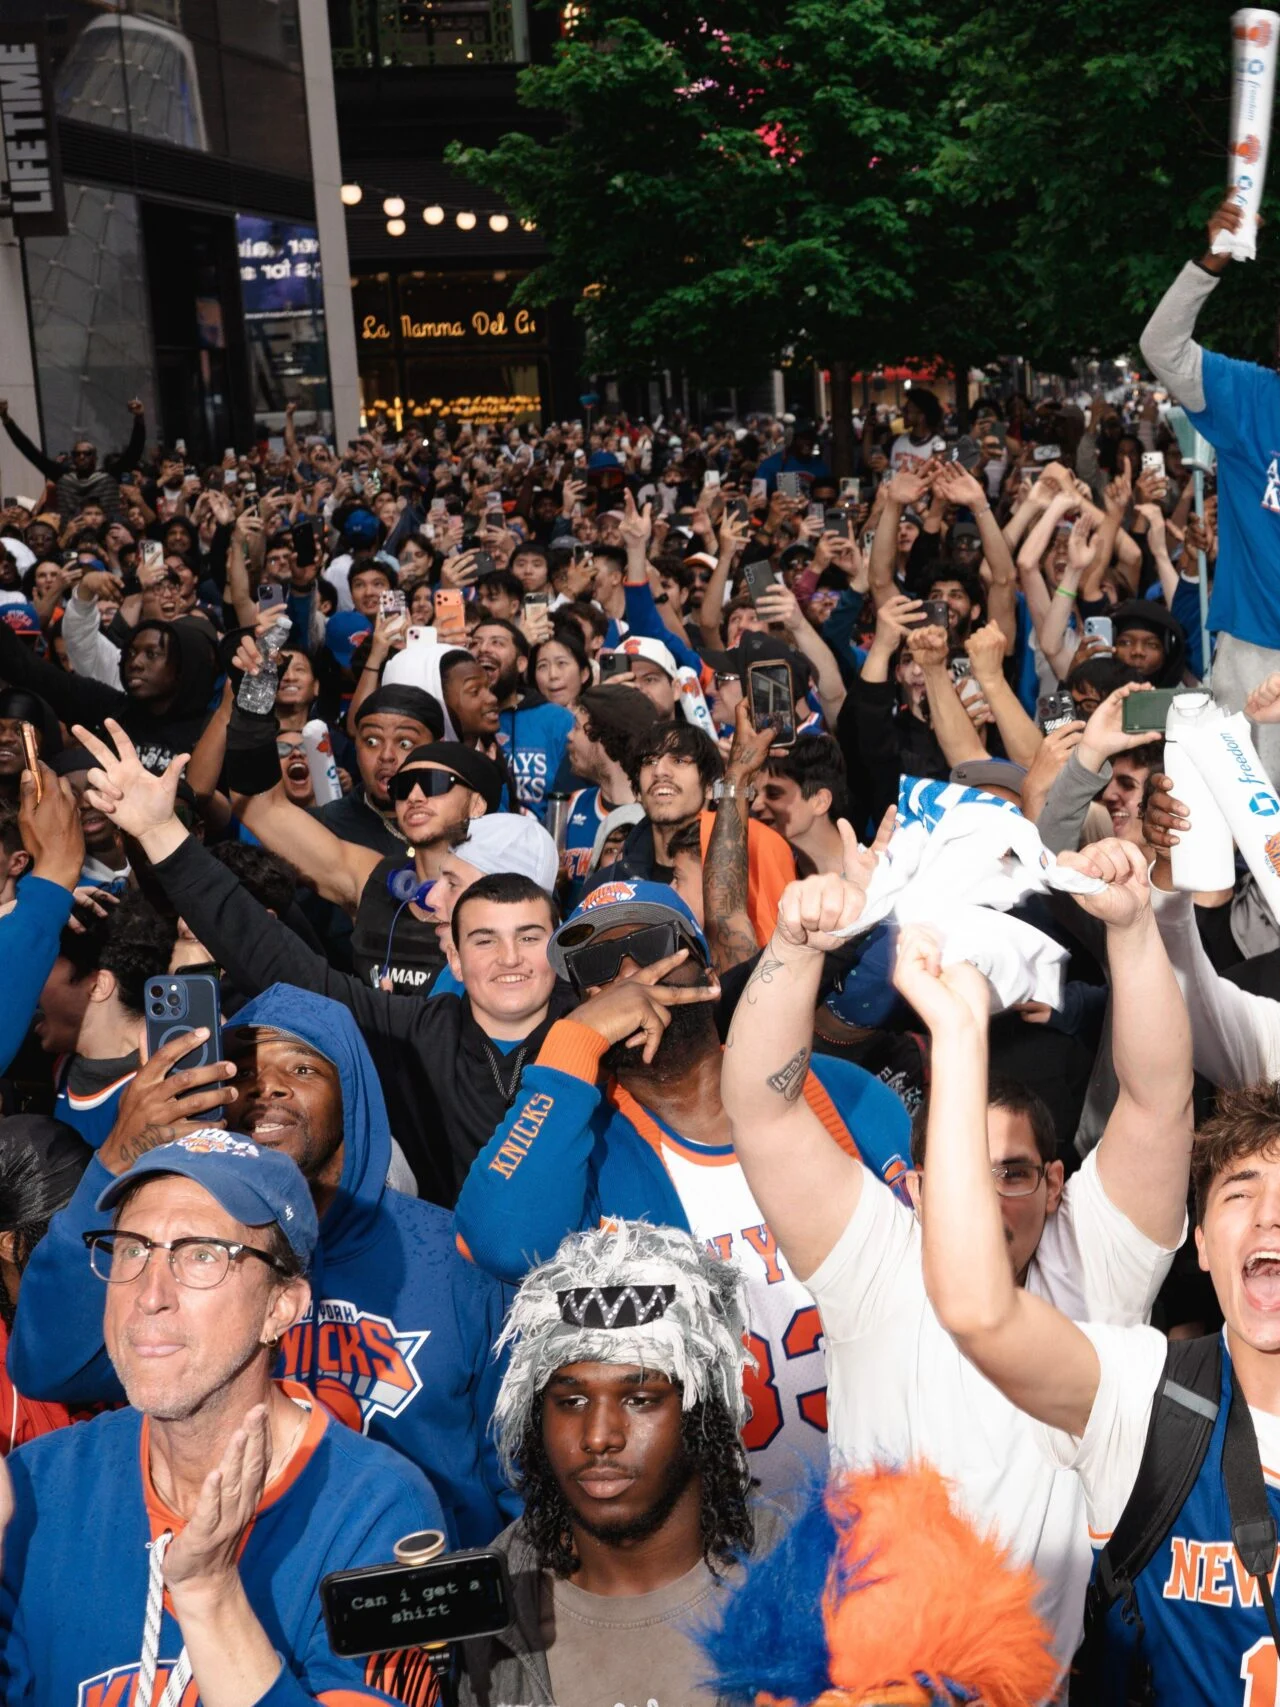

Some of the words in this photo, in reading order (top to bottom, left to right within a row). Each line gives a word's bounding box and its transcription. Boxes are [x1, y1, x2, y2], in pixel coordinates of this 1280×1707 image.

[362, 315, 391, 339] La
[472, 310, 508, 336] Del
[1219, 732, 1266, 786] freedom
[488, 1093, 555, 1180] KNICKS
[280, 1318, 415, 1392] NICKS
[351, 1594, 388, 1611] Can
[399, 1588, 411, 1602] i
[422, 1580, 459, 1600] get
[469, 1579, 481, 1591] a
[391, 1602, 450, 1624] shirt
